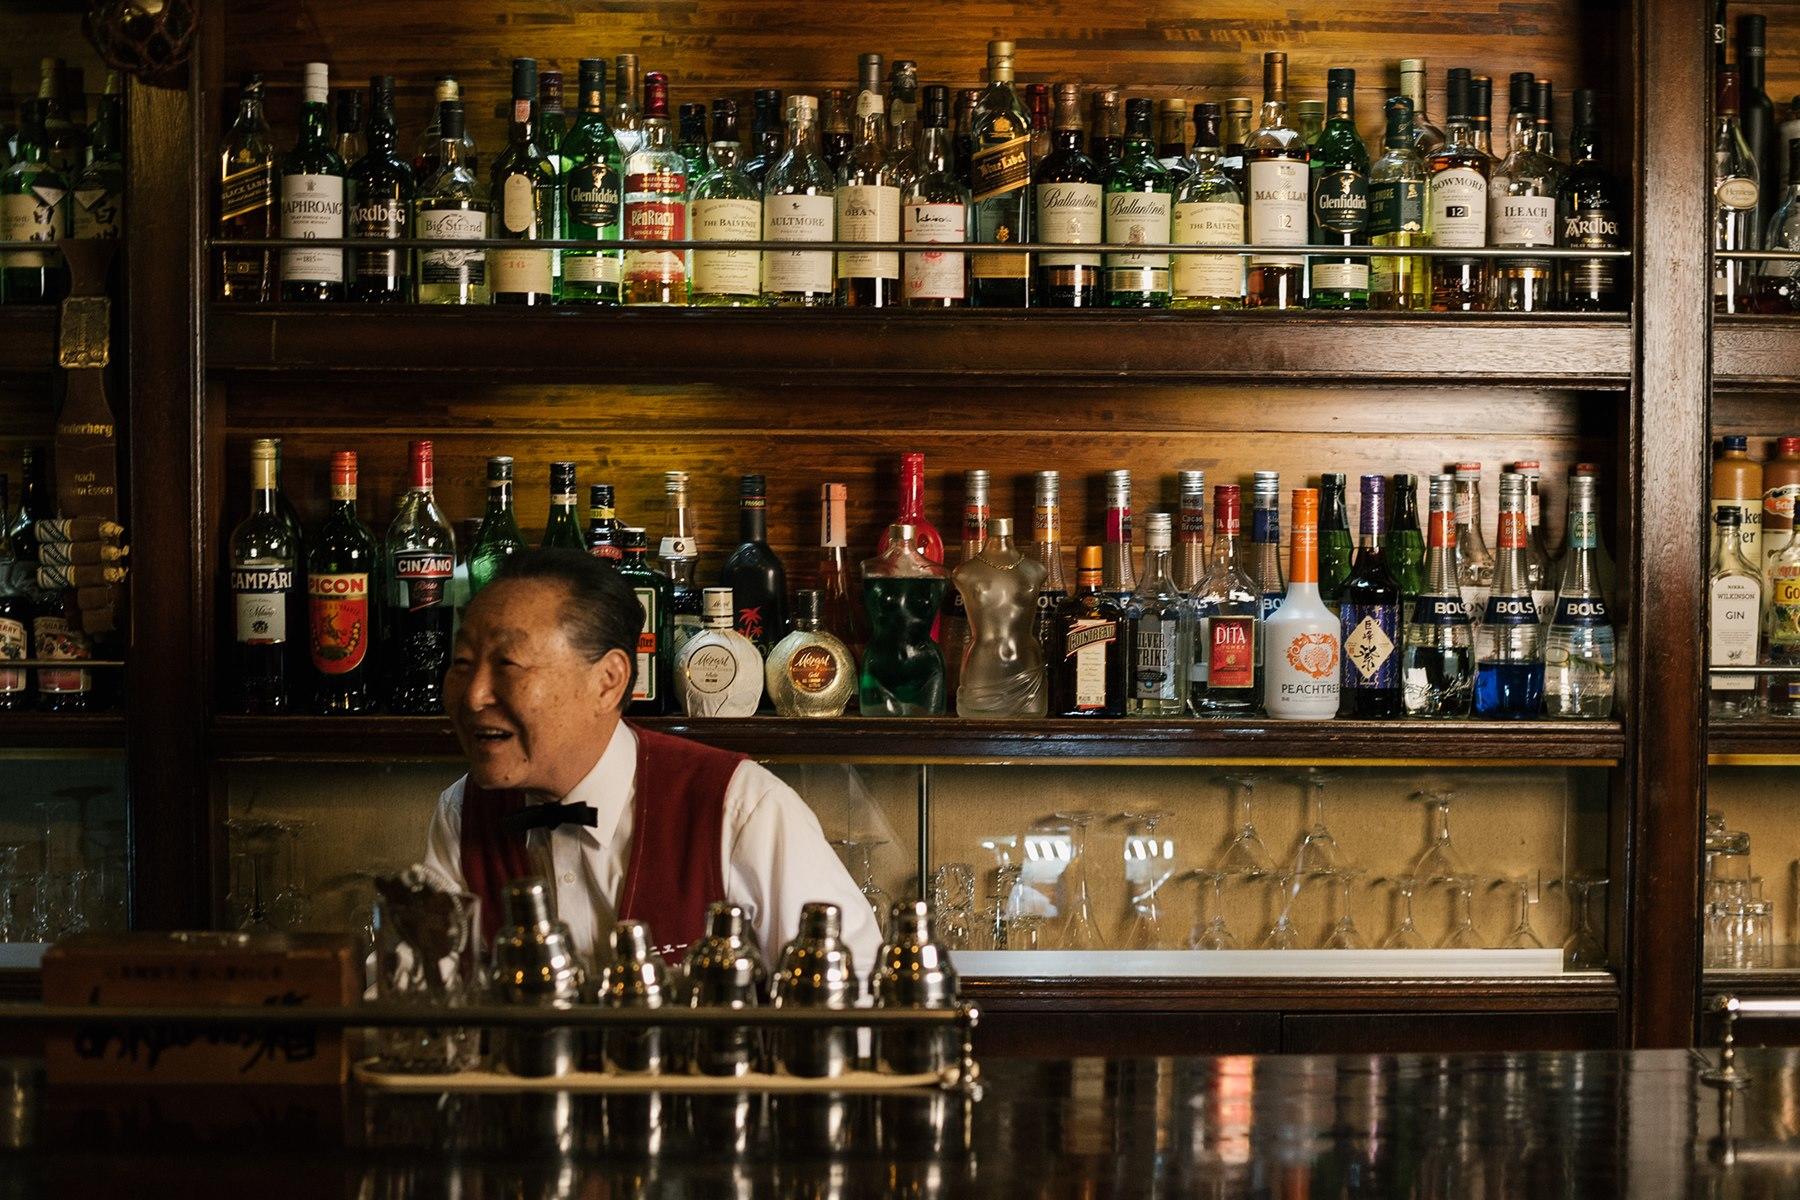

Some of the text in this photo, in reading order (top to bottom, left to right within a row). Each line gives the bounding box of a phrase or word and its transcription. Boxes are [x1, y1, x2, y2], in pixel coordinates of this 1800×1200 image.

[1432, 177, 1484, 193] BOWMORE
[1254, 190, 1308, 201] MACLLAN
[283, 200, 342, 216] APHROAIG
[1450, 207, 1465, 217] 12
[1504, 206, 1548, 218] ILEACH
[425, 220, 443, 235] Big
[770, 217, 825, 228] AULTMORE
[398, 557, 451, 574] CINZANO
[231, 571, 292, 589] CAMPARI
[308, 577, 364, 594] PICON
[1434, 601, 1467, 614] BOLS
[1495, 601, 1535, 614] BOLS
[1566, 603, 1606, 616] BOLS
[1725, 610, 1746, 620] GIN
[1069, 625, 1115, 650] COINTREAU
[1137, 633, 1165, 648] ILVER
[1215, 626, 1246, 645] DITA
[694, 652, 729, 669] Mozart
[795, 652, 830, 669] Mozart
[1281, 683, 1340, 695] PEACHTREE
